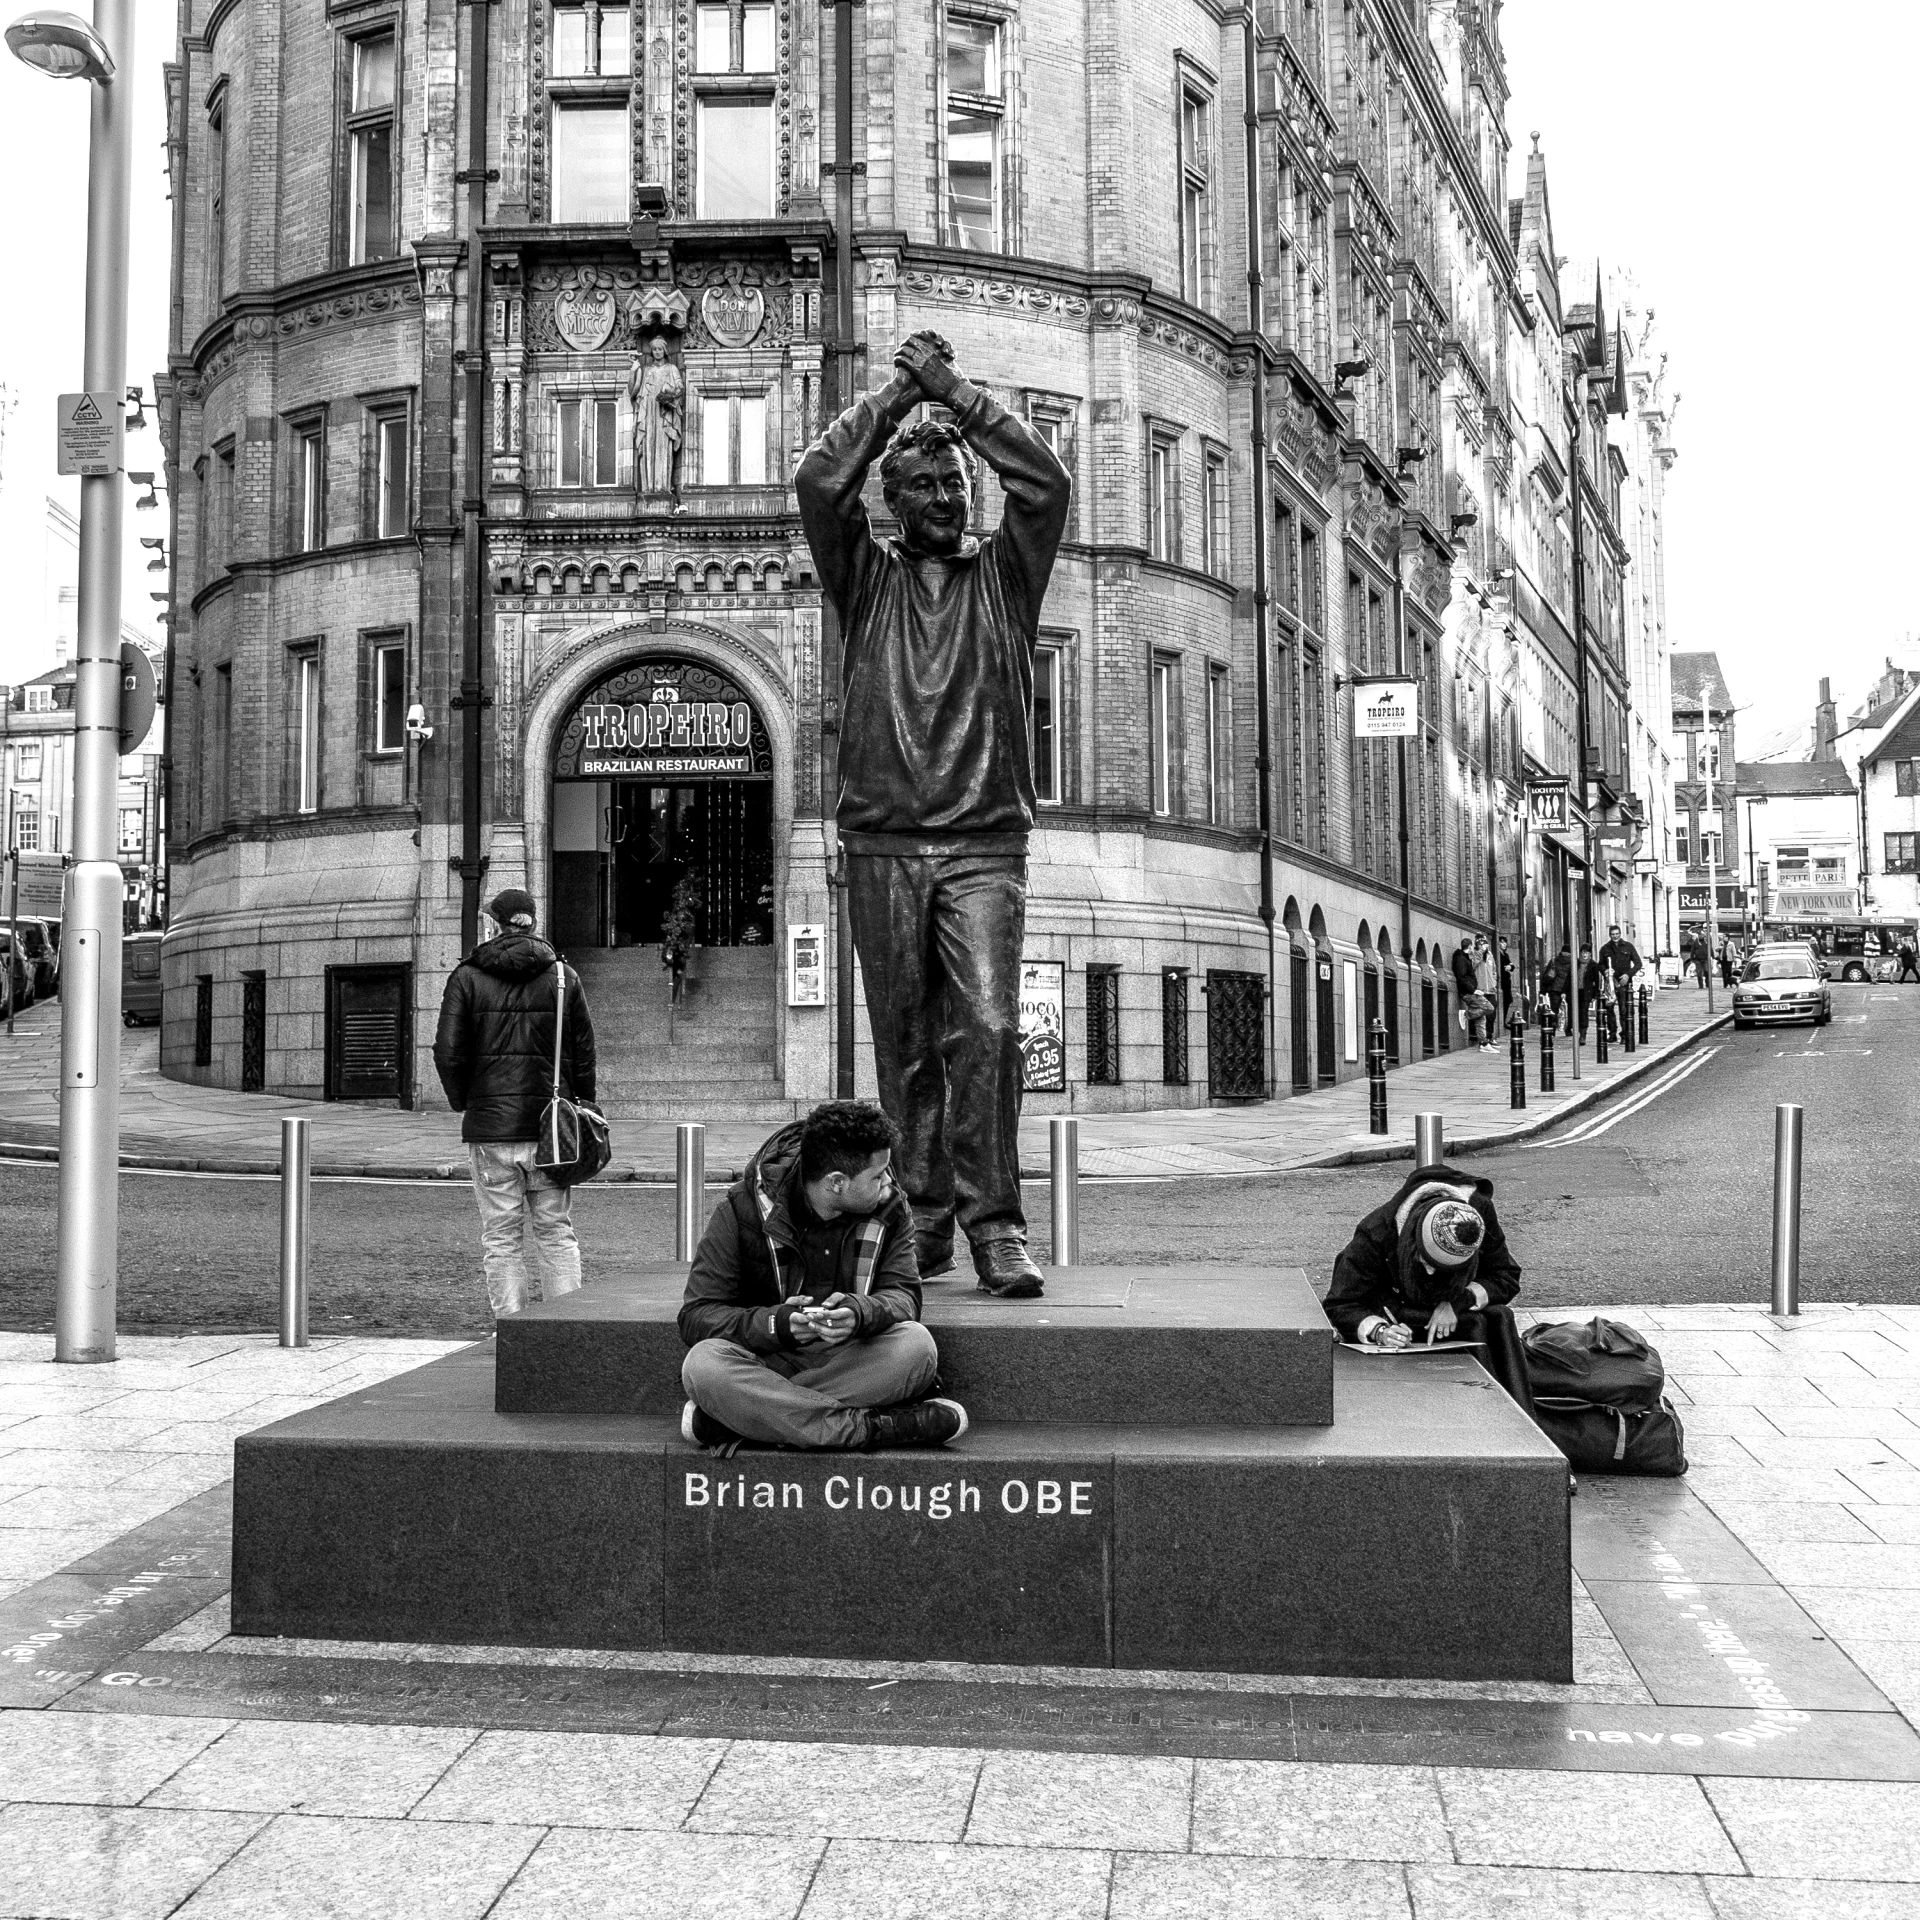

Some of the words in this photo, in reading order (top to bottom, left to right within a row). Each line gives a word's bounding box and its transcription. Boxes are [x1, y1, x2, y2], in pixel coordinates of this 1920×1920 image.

[567, 303, 605, 315] ANNO
[718, 300, 748, 313] DOM
[565, 316, 607, 335] MDCCC
[1367, 707, 1405, 717] TROPEIRO
[583, 702, 750, 748] TROPEIRO
[584, 761, 653, 773] BRAZILIAN
[656, 759, 744, 772] RESTAURANT
[1815, 873, 1844, 882] PARIS
[1781, 896, 1799, 909] NEW
[1801, 895, 1826, 909] YORK
[1827, 894, 1853, 909] NAILS
[1026, 1048, 1060, 1072] £9.95
[685, 1472, 803, 1508] Brian
[824, 1475, 981, 1520] Clough
[1000, 1479, 1093, 1515] OBE
[1723, 1656, 1770, 1674] up
[1738, 1676, 1812, 1722] grass
[1568, 1726, 1705, 1746] have
